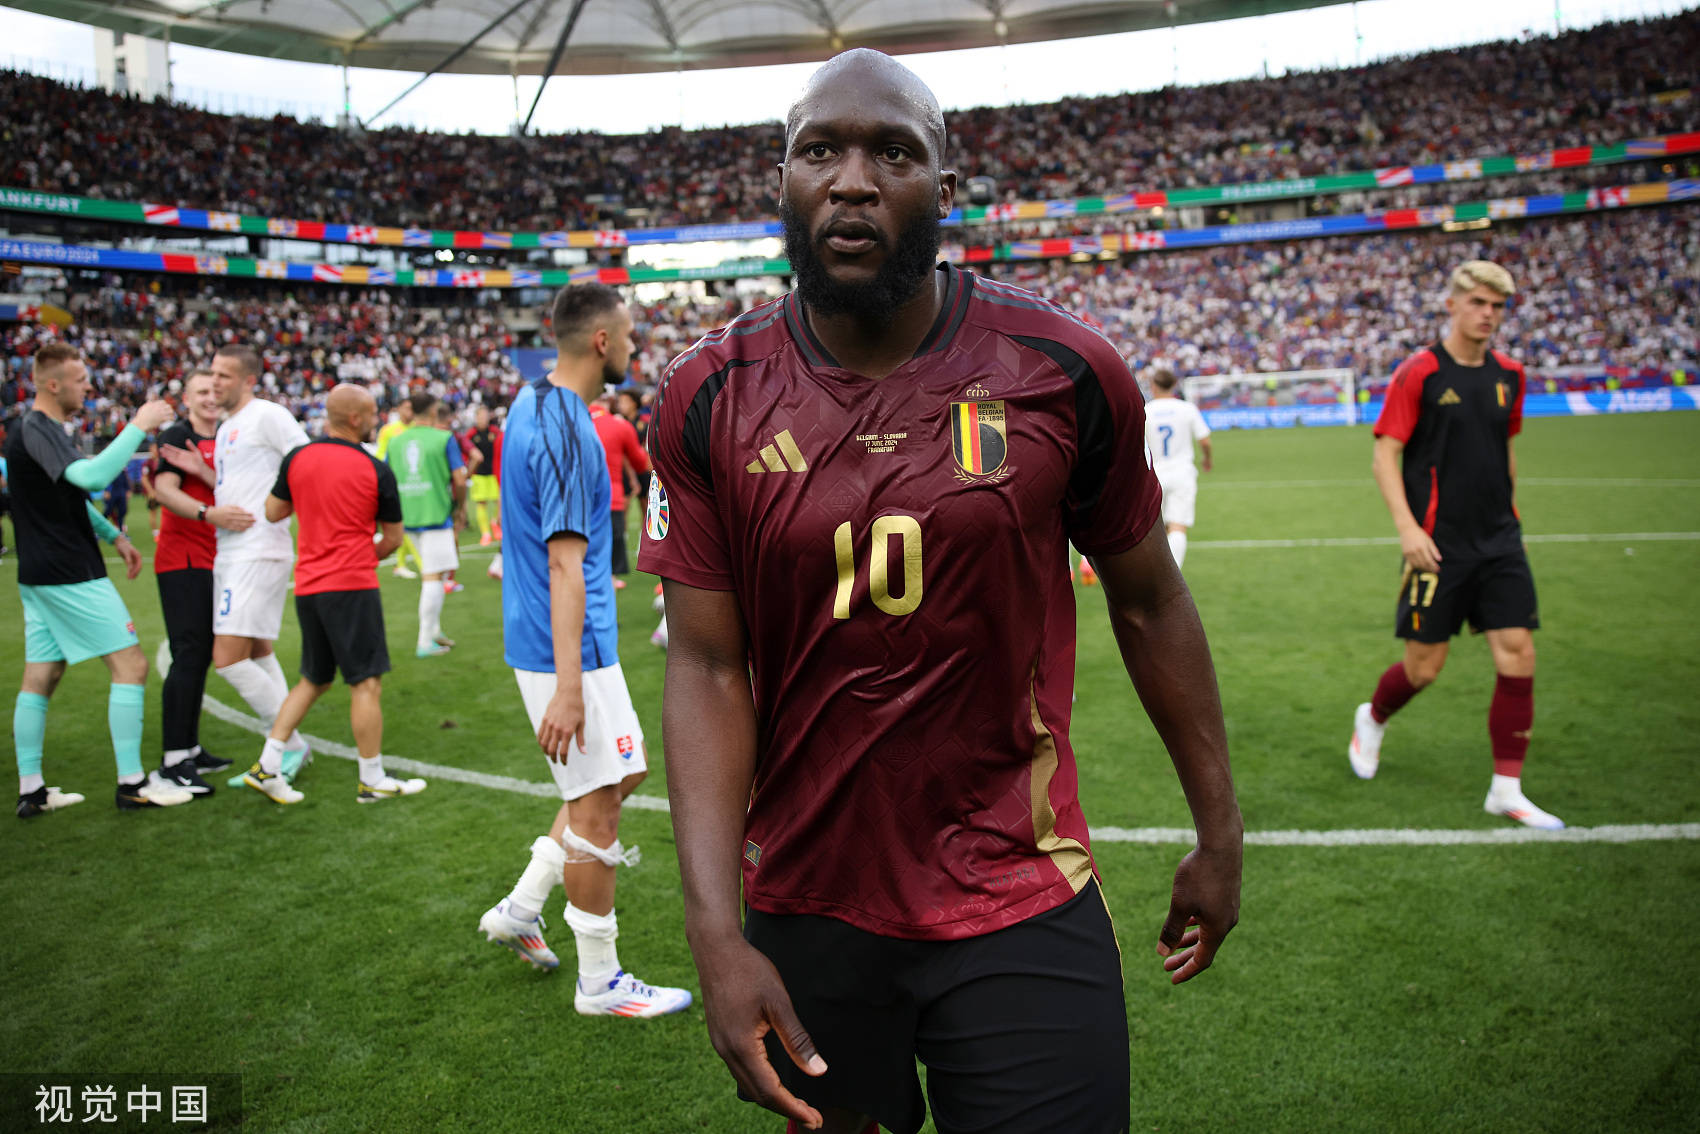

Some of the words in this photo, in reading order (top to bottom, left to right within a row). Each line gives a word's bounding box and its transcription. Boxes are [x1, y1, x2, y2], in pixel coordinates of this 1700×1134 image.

[1158, 425, 1173, 457] 7
[833, 515, 923, 619] 10
[220, 589, 232, 616] 3
[1409, 571, 1439, 607] 17
